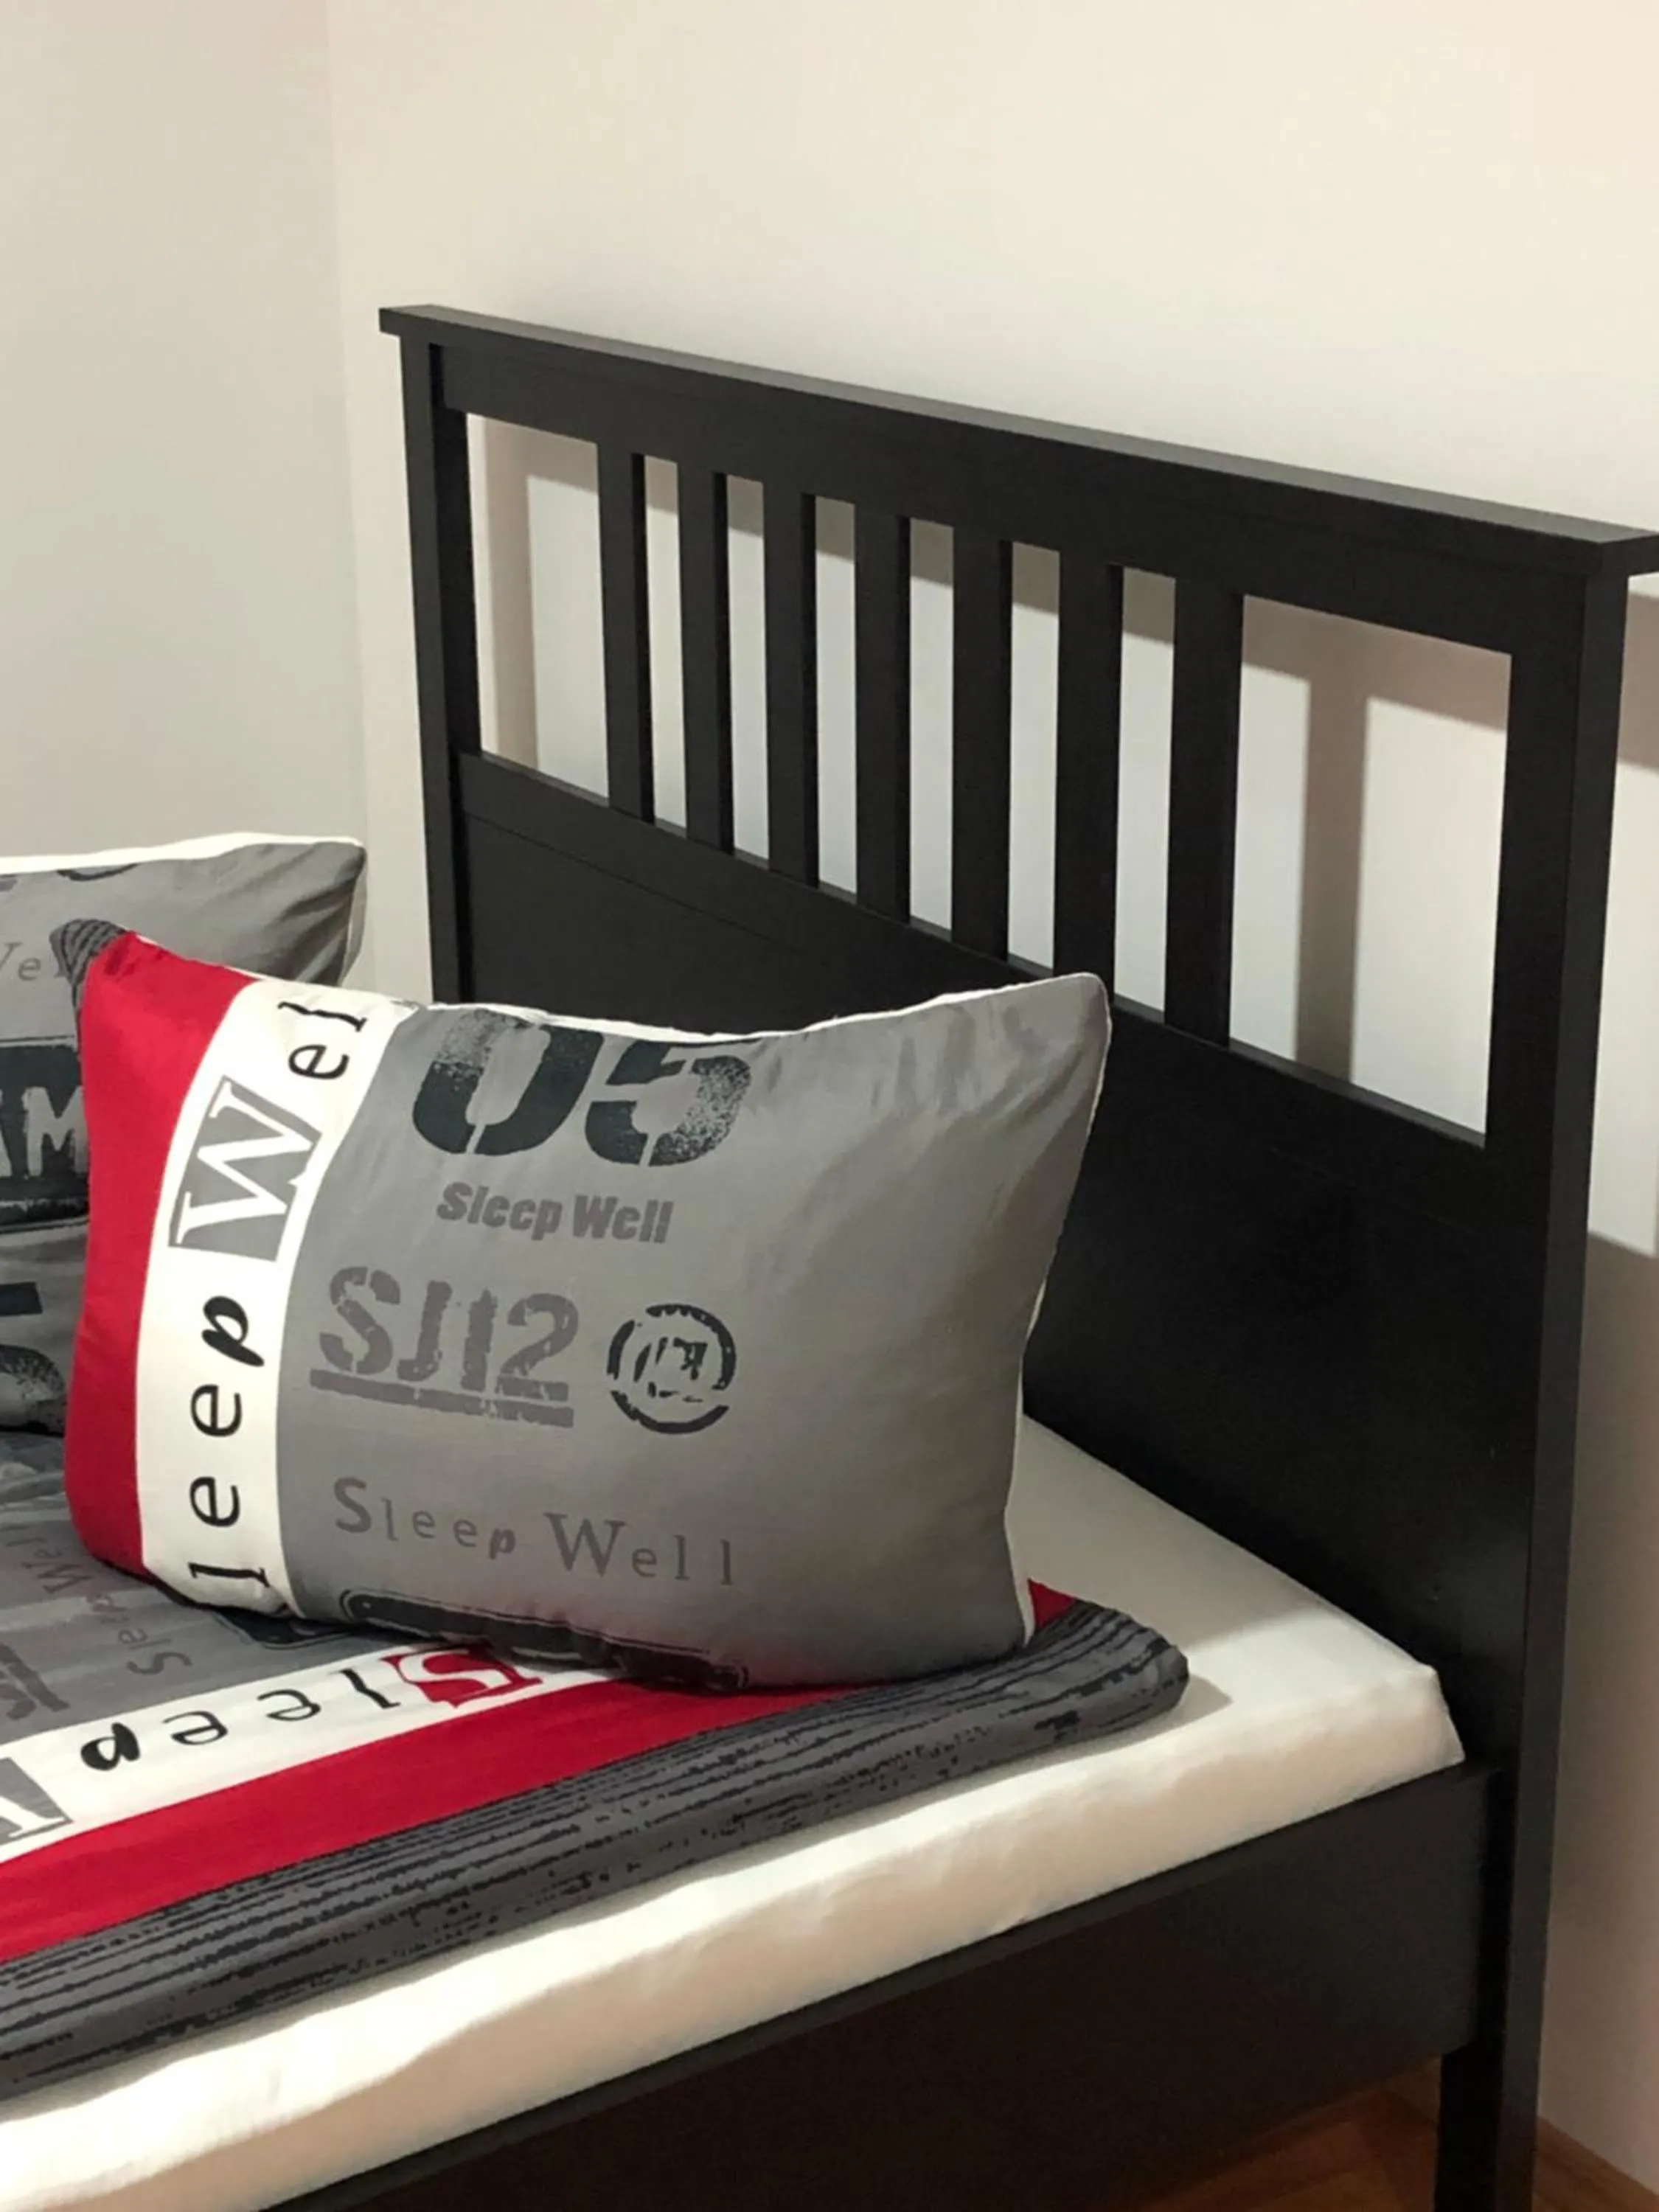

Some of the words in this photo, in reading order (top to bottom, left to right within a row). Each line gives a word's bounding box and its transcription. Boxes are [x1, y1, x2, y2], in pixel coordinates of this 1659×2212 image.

[412, 1010, 751, 1166] 05
[437, 1181, 563, 1241] Sleep
[573, 1195, 675, 1244] Well
[333, 1477, 517, 1559] Sleep
[543, 1512, 734, 1586] Well
[80, 1647, 538, 1771] Sleep
